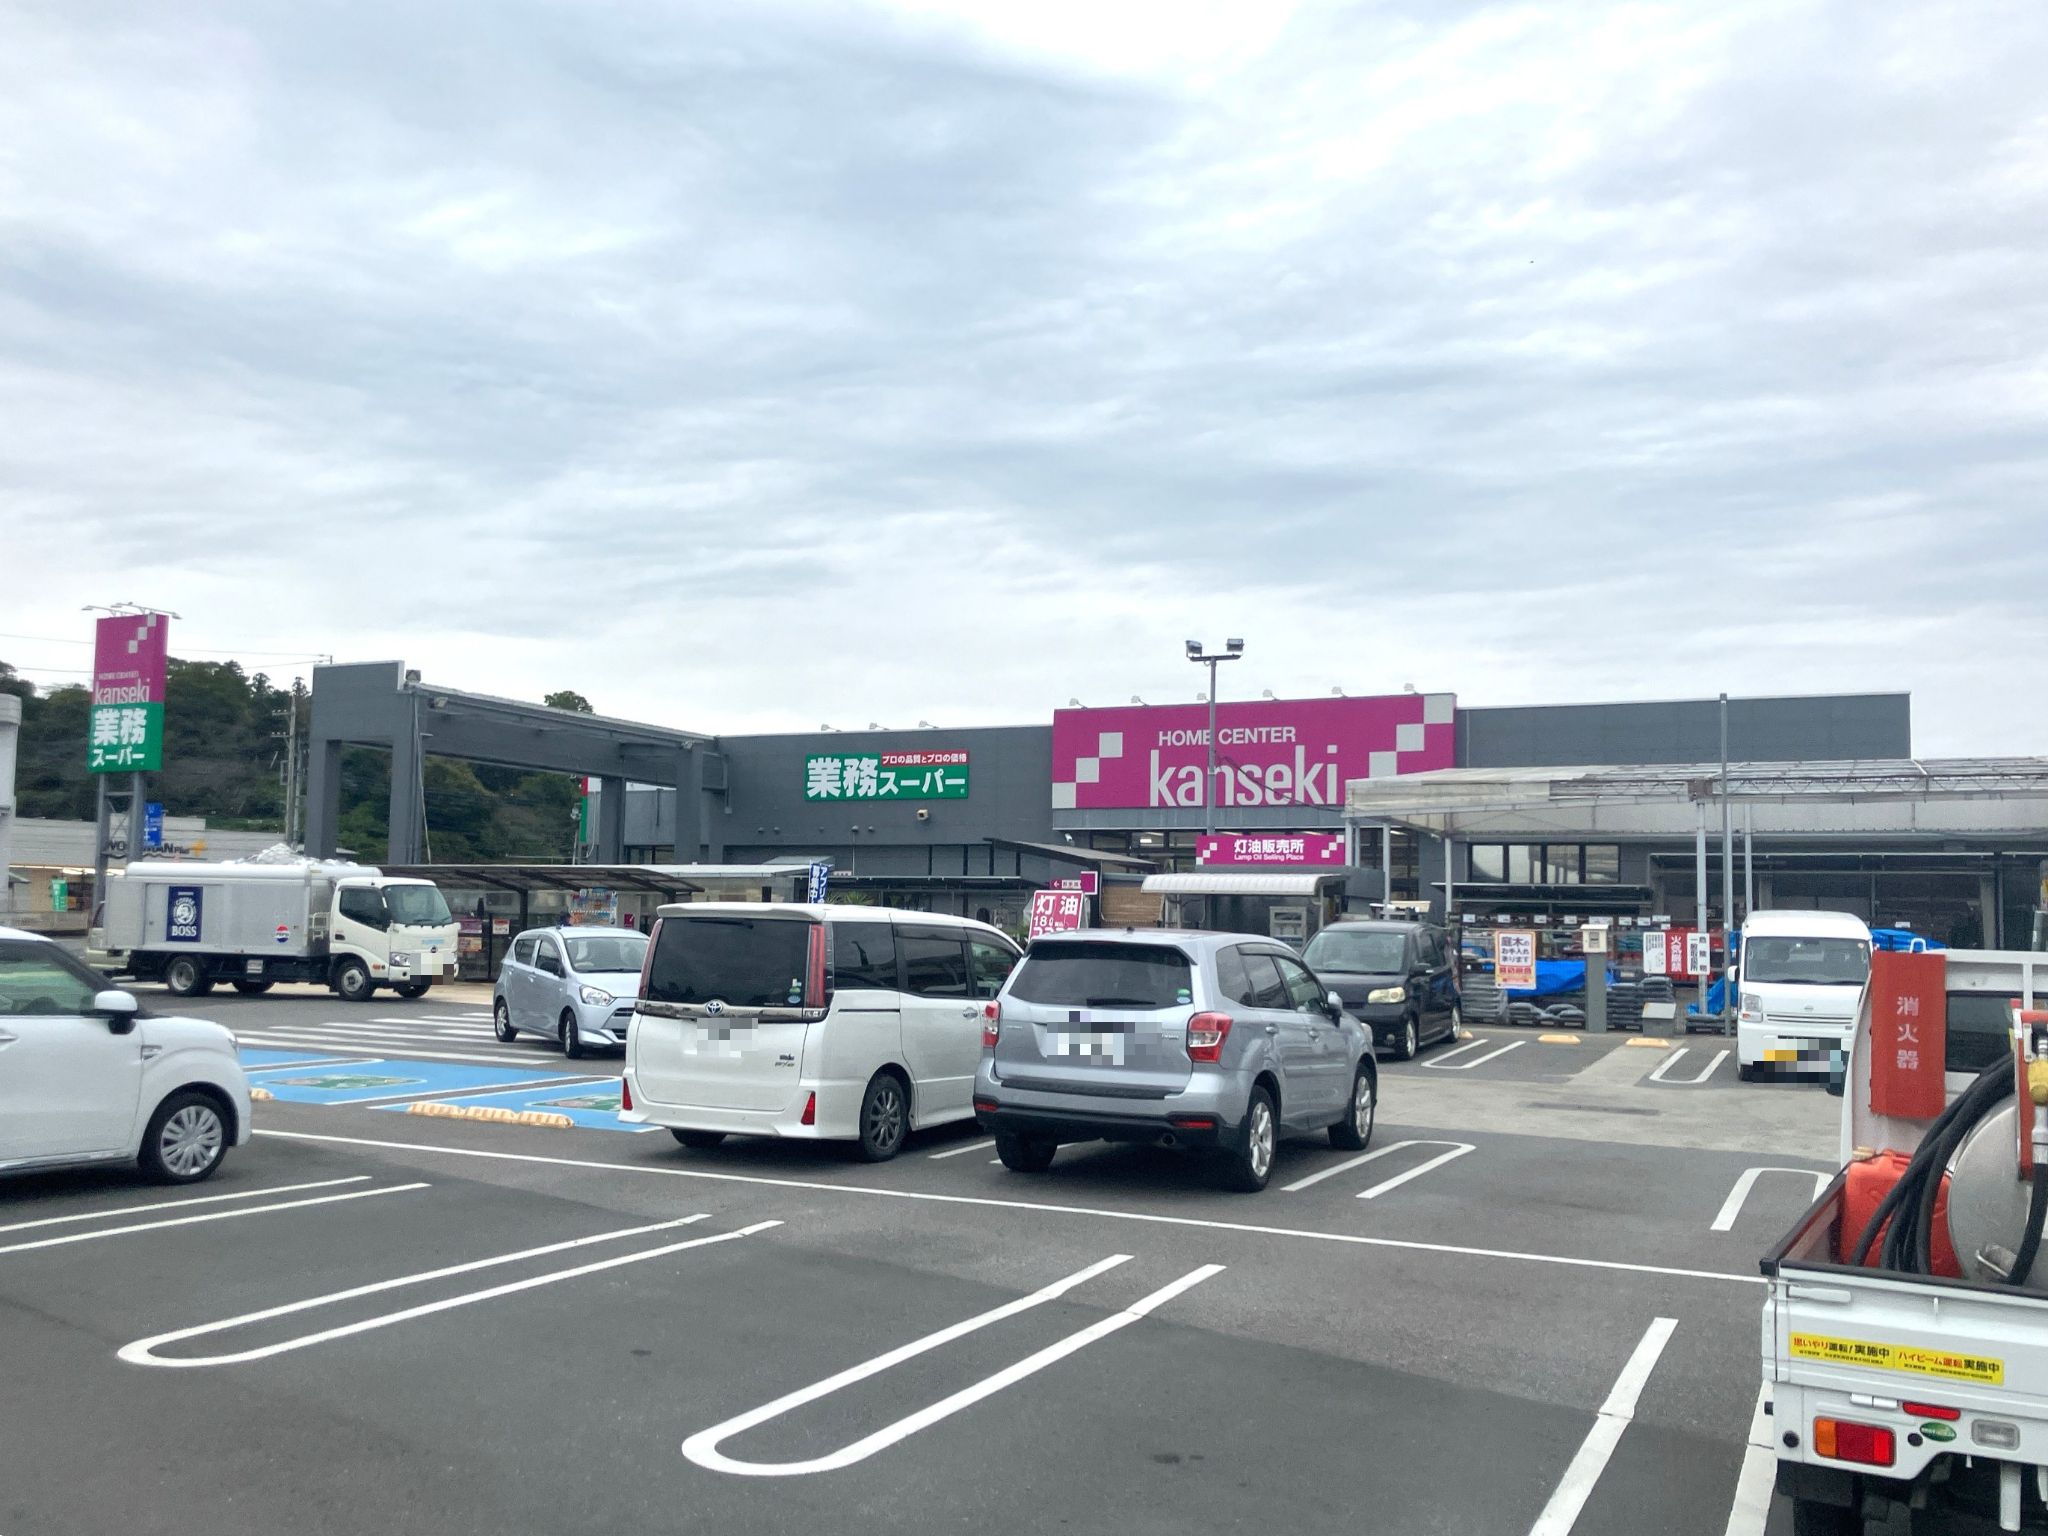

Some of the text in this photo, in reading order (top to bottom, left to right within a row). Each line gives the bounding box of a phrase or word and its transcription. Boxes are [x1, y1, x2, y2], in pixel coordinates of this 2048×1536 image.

[95, 678, 150, 704] kanseki
[94, 708, 147, 746] 業務
[1158, 726, 1296, 747] HOME CENTER
[92, 745, 145, 767] スーパー
[882, 753, 967, 765] プロの品質とプロの価格
[806, 756, 966, 798] 業務スーパー
[1150, 744, 1338, 807] kanseki
[1234, 839, 1305, 853] 灯油販売所
[1036, 895, 1079, 915] 灯油
[172, 926, 197, 936] BOSS
[1896, 996, 1920, 1071] 消火器
[1898, 1351, 2001, 1373] ハイビーム運転実施中
